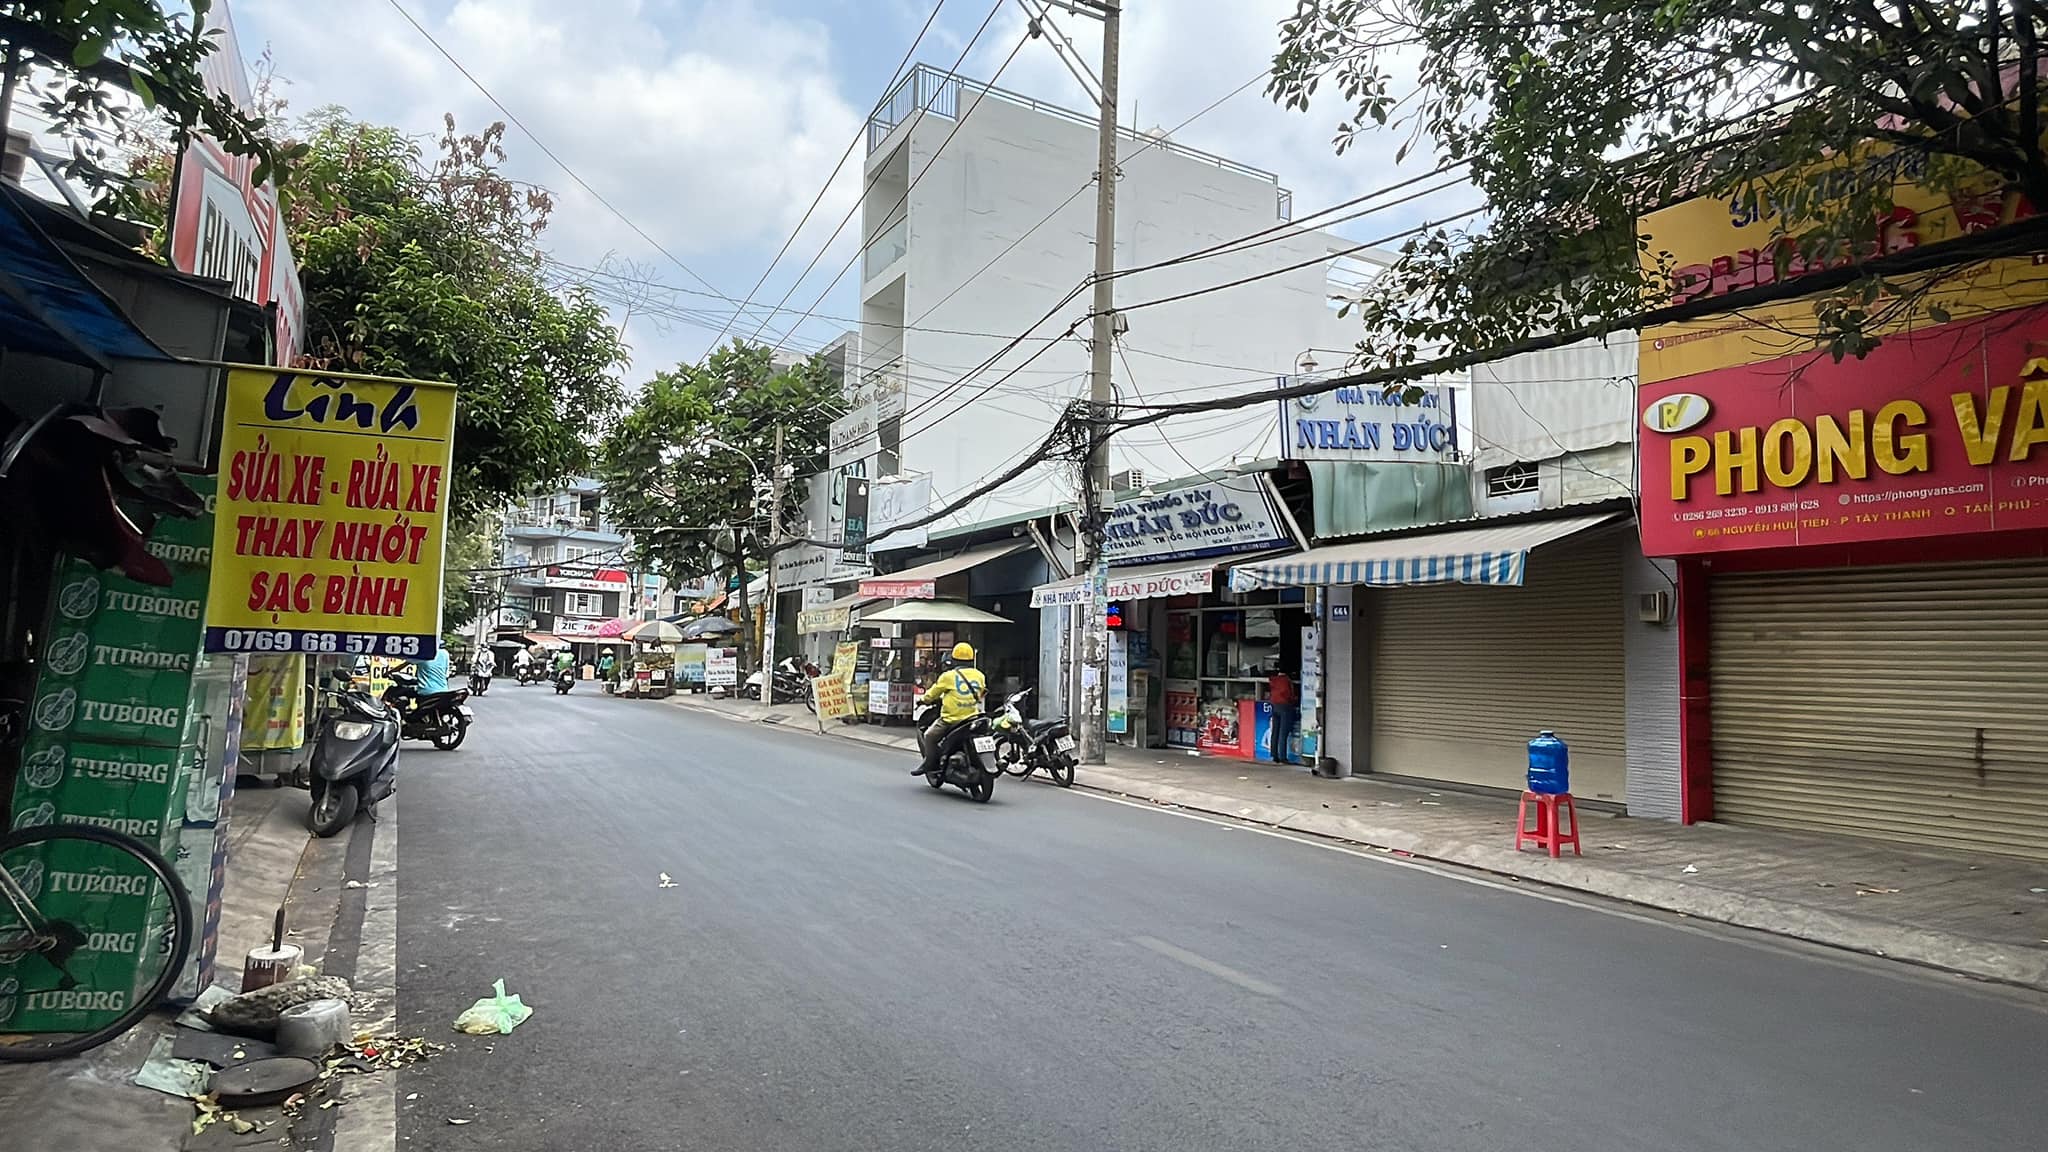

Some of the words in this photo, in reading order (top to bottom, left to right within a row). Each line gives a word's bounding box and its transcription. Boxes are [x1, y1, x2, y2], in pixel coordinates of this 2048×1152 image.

[1336, 386, 1365, 405] NHÀ
[1296, 414, 1381, 451] NHÂN
[1392, 413, 1447, 453] ĐỨC
[1670, 399, 1929, 501] PHONG
[226, 433, 281, 502] SỬA
[287, 454, 326, 505] XE
[346, 443, 399, 511] RỬA
[404, 464, 442, 513] XE
[1138, 493, 1182, 513] THUỐC
[1180, 502, 1243, 529] ĐỨC
[1682, 512, 1704, 522] 0286
[1724, 507, 1747, 518] 3239
[1755, 504, 1778, 514] 0913
[1801, 500, 1819, 510] 628
[236, 515, 324, 559] THAY
[330, 513, 428, 565] NHỚT
[248, 570, 317, 624] SẠC
[323, 564, 408, 617] BÌNH
[1043, 592, 1057, 604] NHÀ
[1110, 582, 1142, 597] HÂN
[1147, 577, 1181, 593] ĐỨC
[105, 589, 199, 619] TUBORG
[562, 622, 577, 631] ZIC
[224, 630, 292, 650] 0769
[301, 632, 337, 651] 68
[346, 634, 376, 654] 57
[384, 635, 419, 655] 83
[82, 700, 179, 728] TUBORG
[71, 756, 168, 784] TUBORG
[49, 871, 147, 895] TUBORG
[77, 932, 137, 953] ORG
[25, 989, 125, 1011] TUBORG
